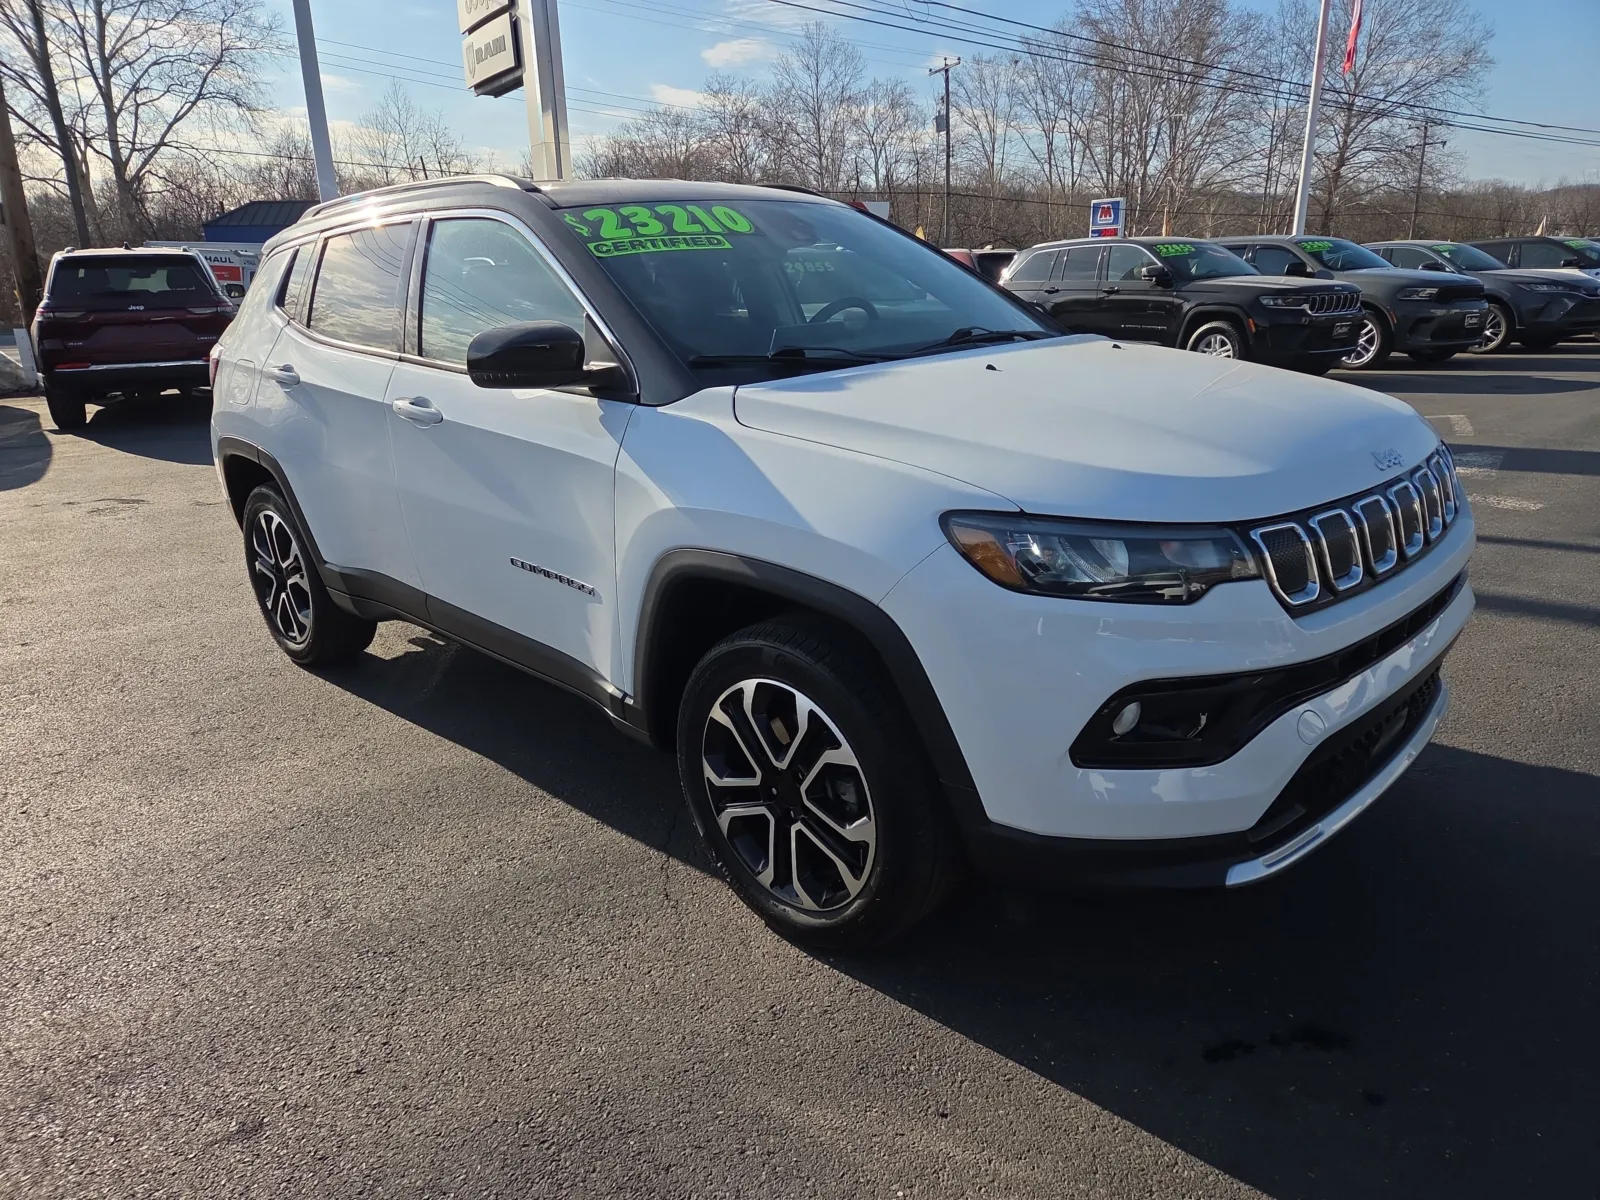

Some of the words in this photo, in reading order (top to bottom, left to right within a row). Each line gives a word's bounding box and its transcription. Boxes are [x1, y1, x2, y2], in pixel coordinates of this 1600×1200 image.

[475, 35, 506, 65] RAM
[564, 205, 755, 238] $23210
[593, 236, 726, 254] CERTIFIED
[509, 557, 596, 597] COMPASS
